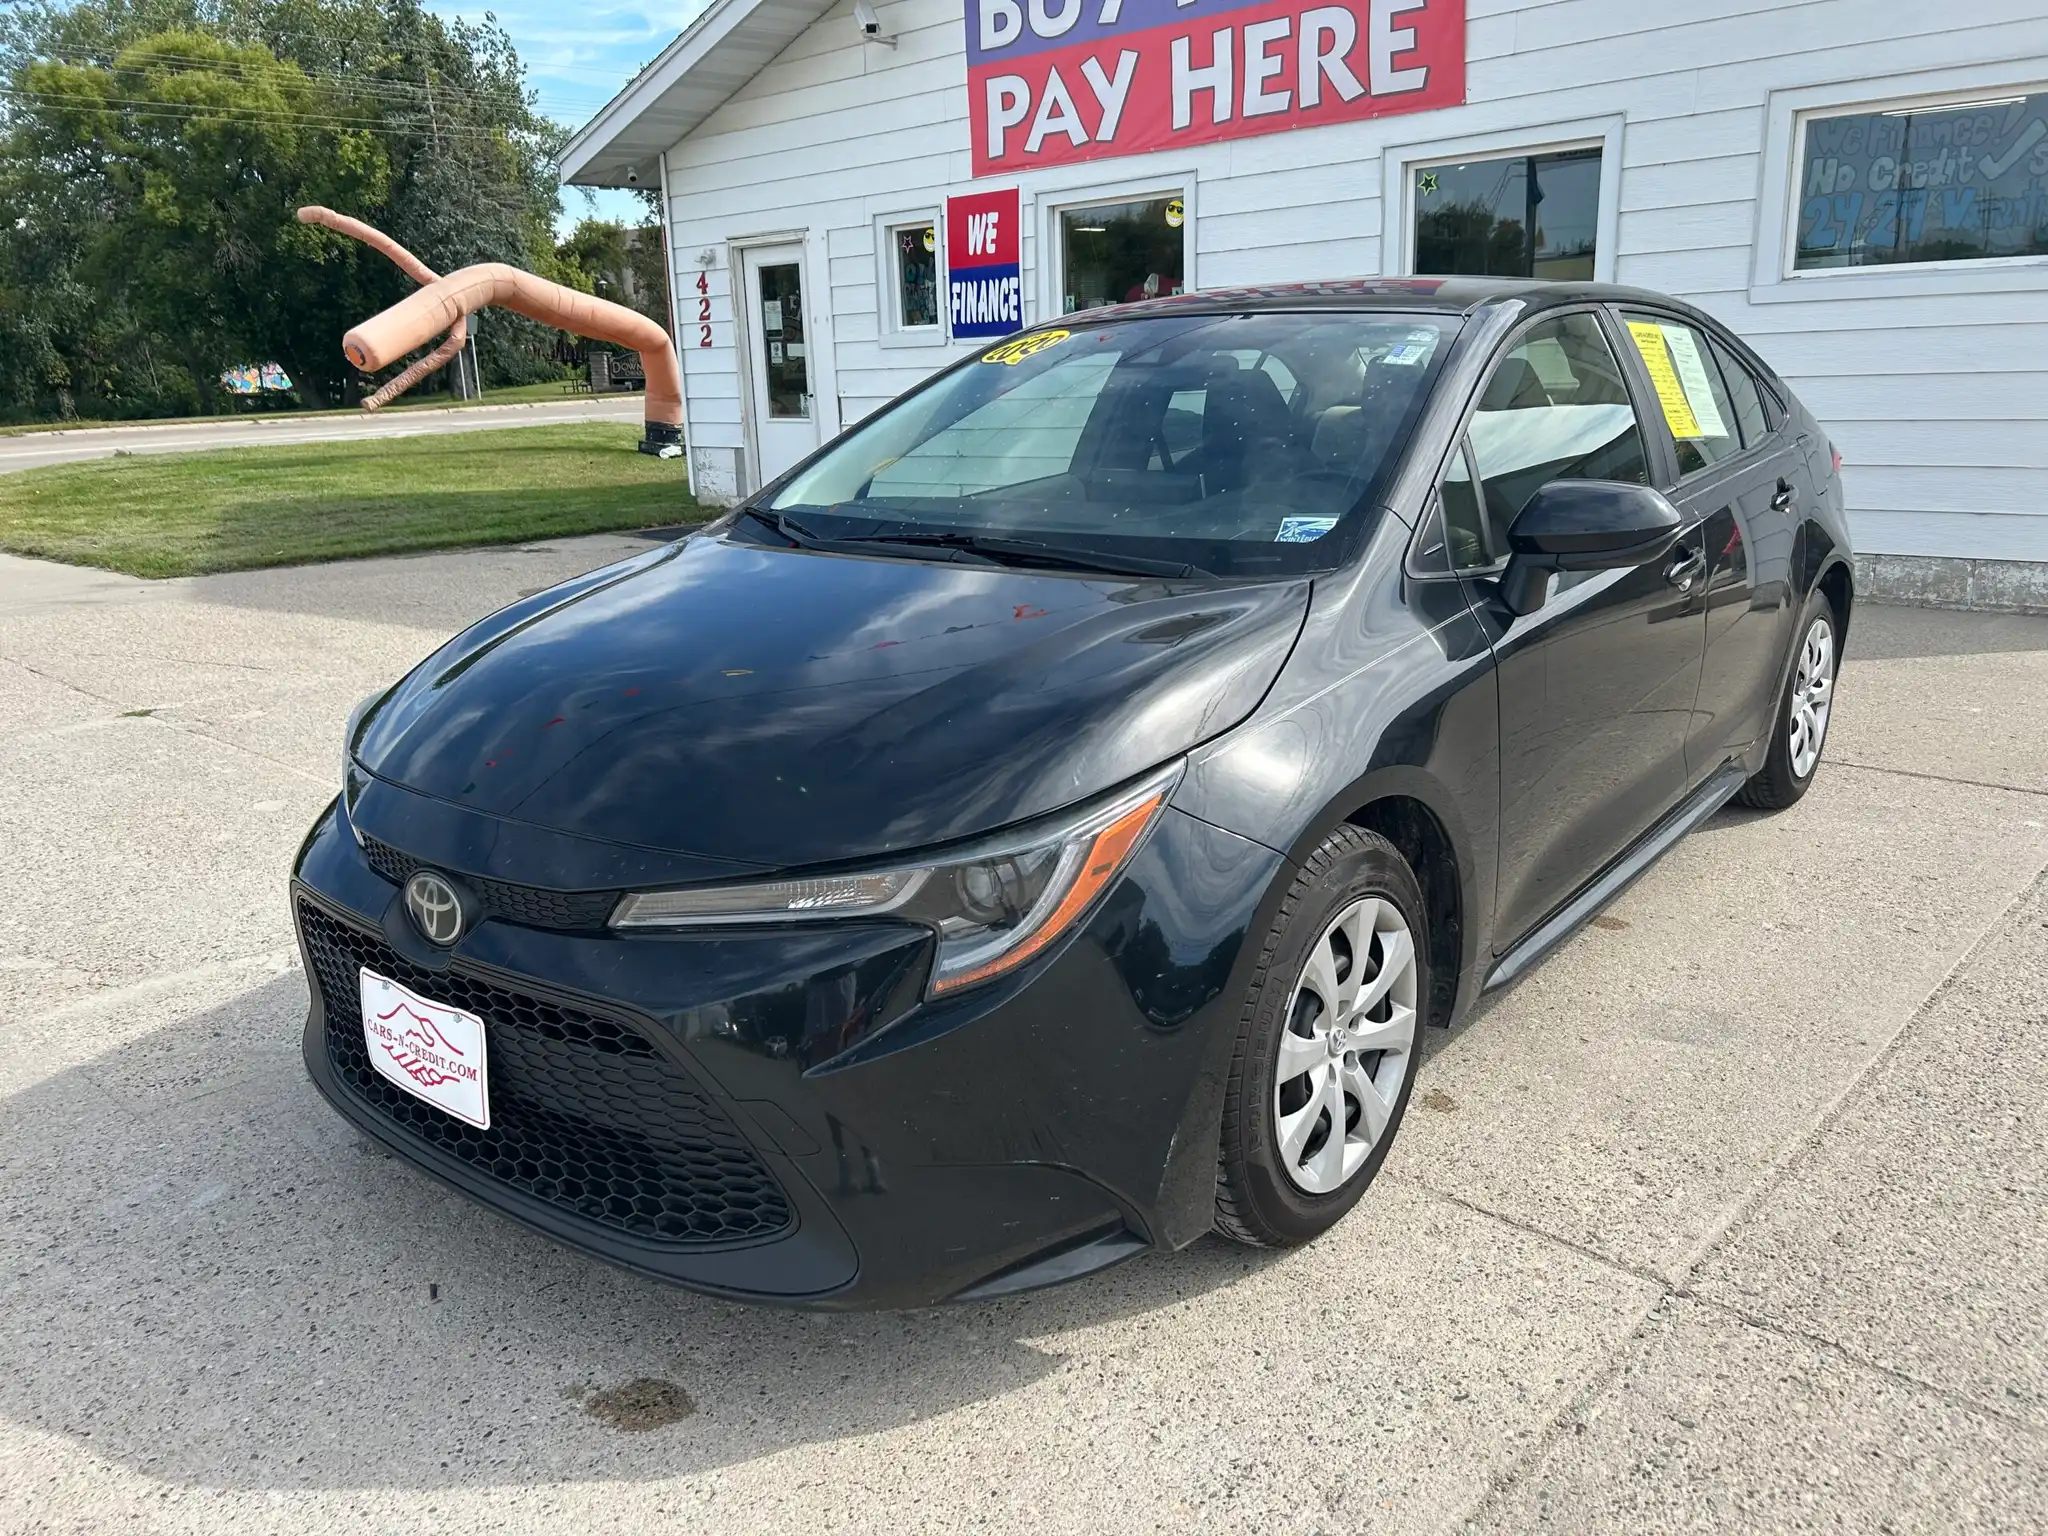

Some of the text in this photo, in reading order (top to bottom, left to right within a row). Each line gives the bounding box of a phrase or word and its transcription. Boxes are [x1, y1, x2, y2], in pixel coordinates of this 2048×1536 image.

[985, 0, 1430, 160] PAY HERE
[1806, 147, 1976, 195] No Credit
[968, 211, 999, 256] WE
[696, 270, 713, 348] 422
[952, 277, 1019, 325] FINANCE
[367, 1018, 478, 1082] CARS-N-CREDIT.COM
